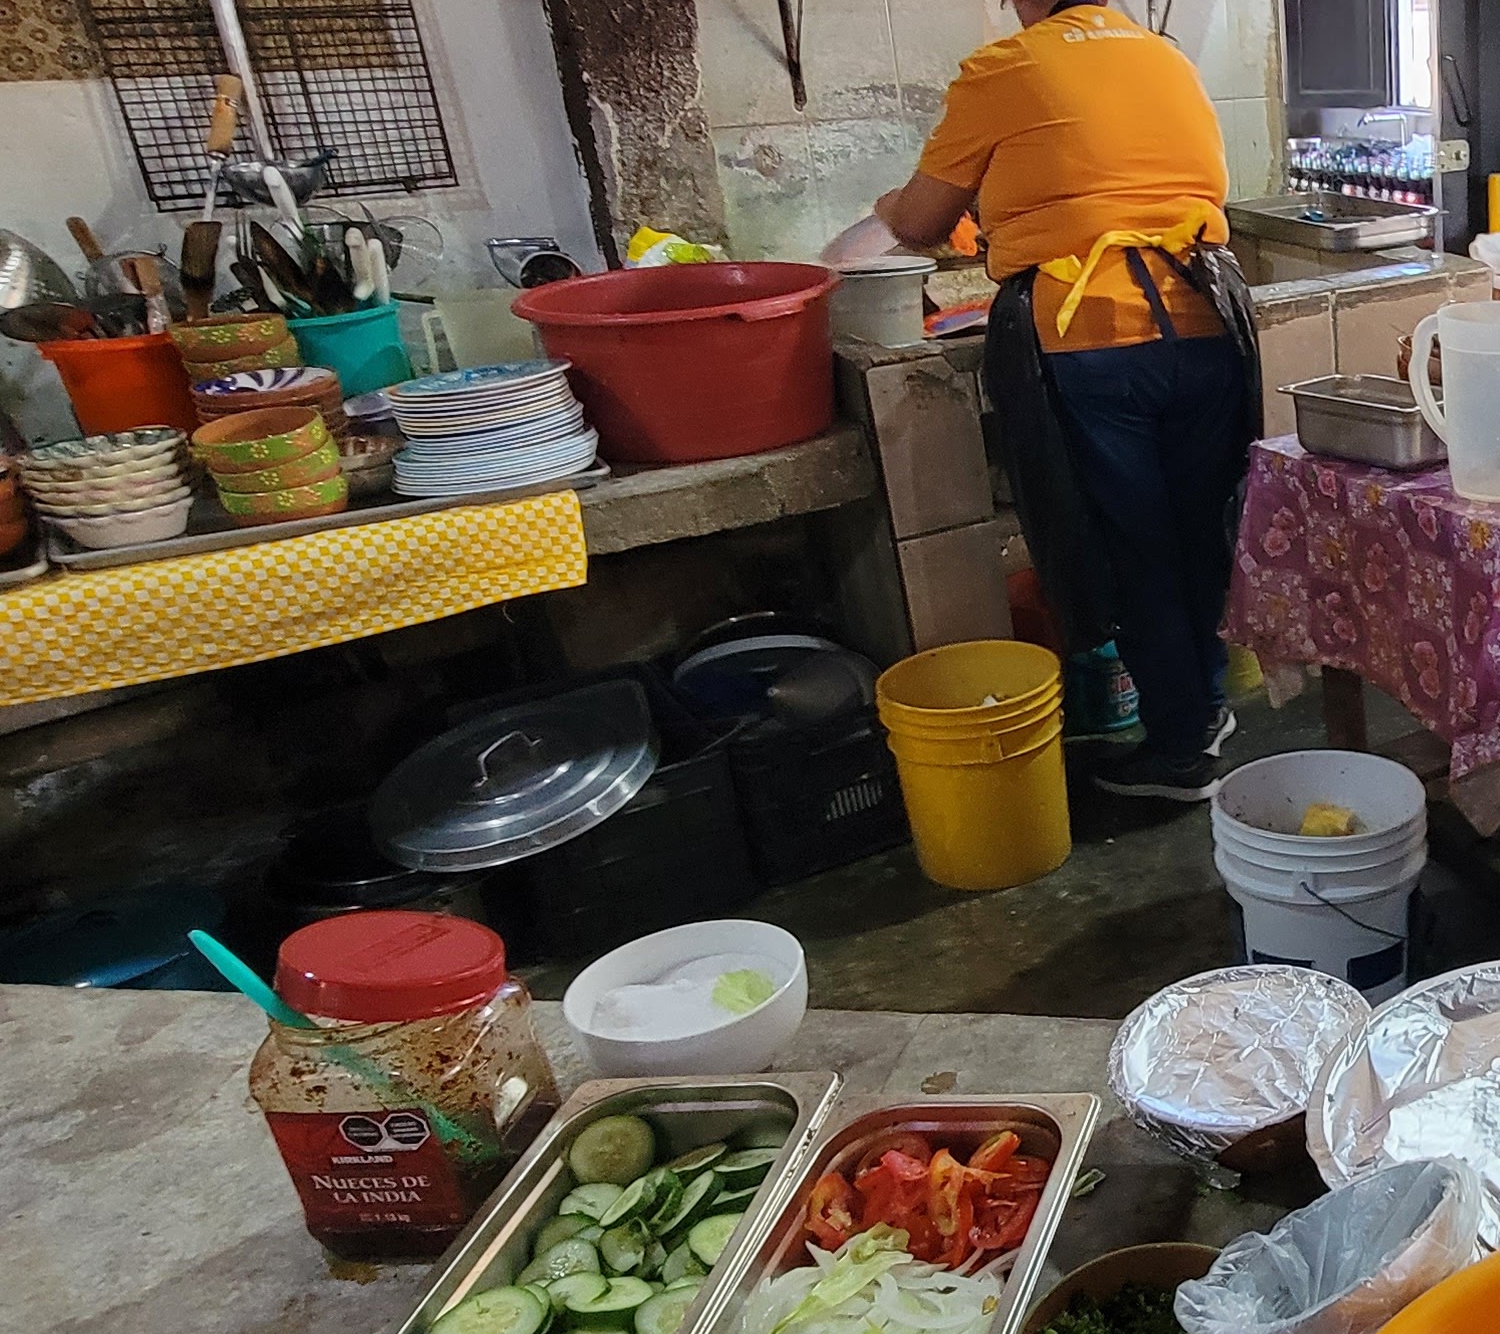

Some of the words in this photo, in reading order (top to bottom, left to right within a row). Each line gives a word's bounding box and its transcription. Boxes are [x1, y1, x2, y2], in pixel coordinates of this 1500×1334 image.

[331, 1155, 393, 1164] KIRKLAND
[310, 1174, 398, 1190] NUECES
[401, 1174, 432, 1189] DE
[333, 1191, 359, 1204] LA
[361, 1190, 423, 1203] INDIA
